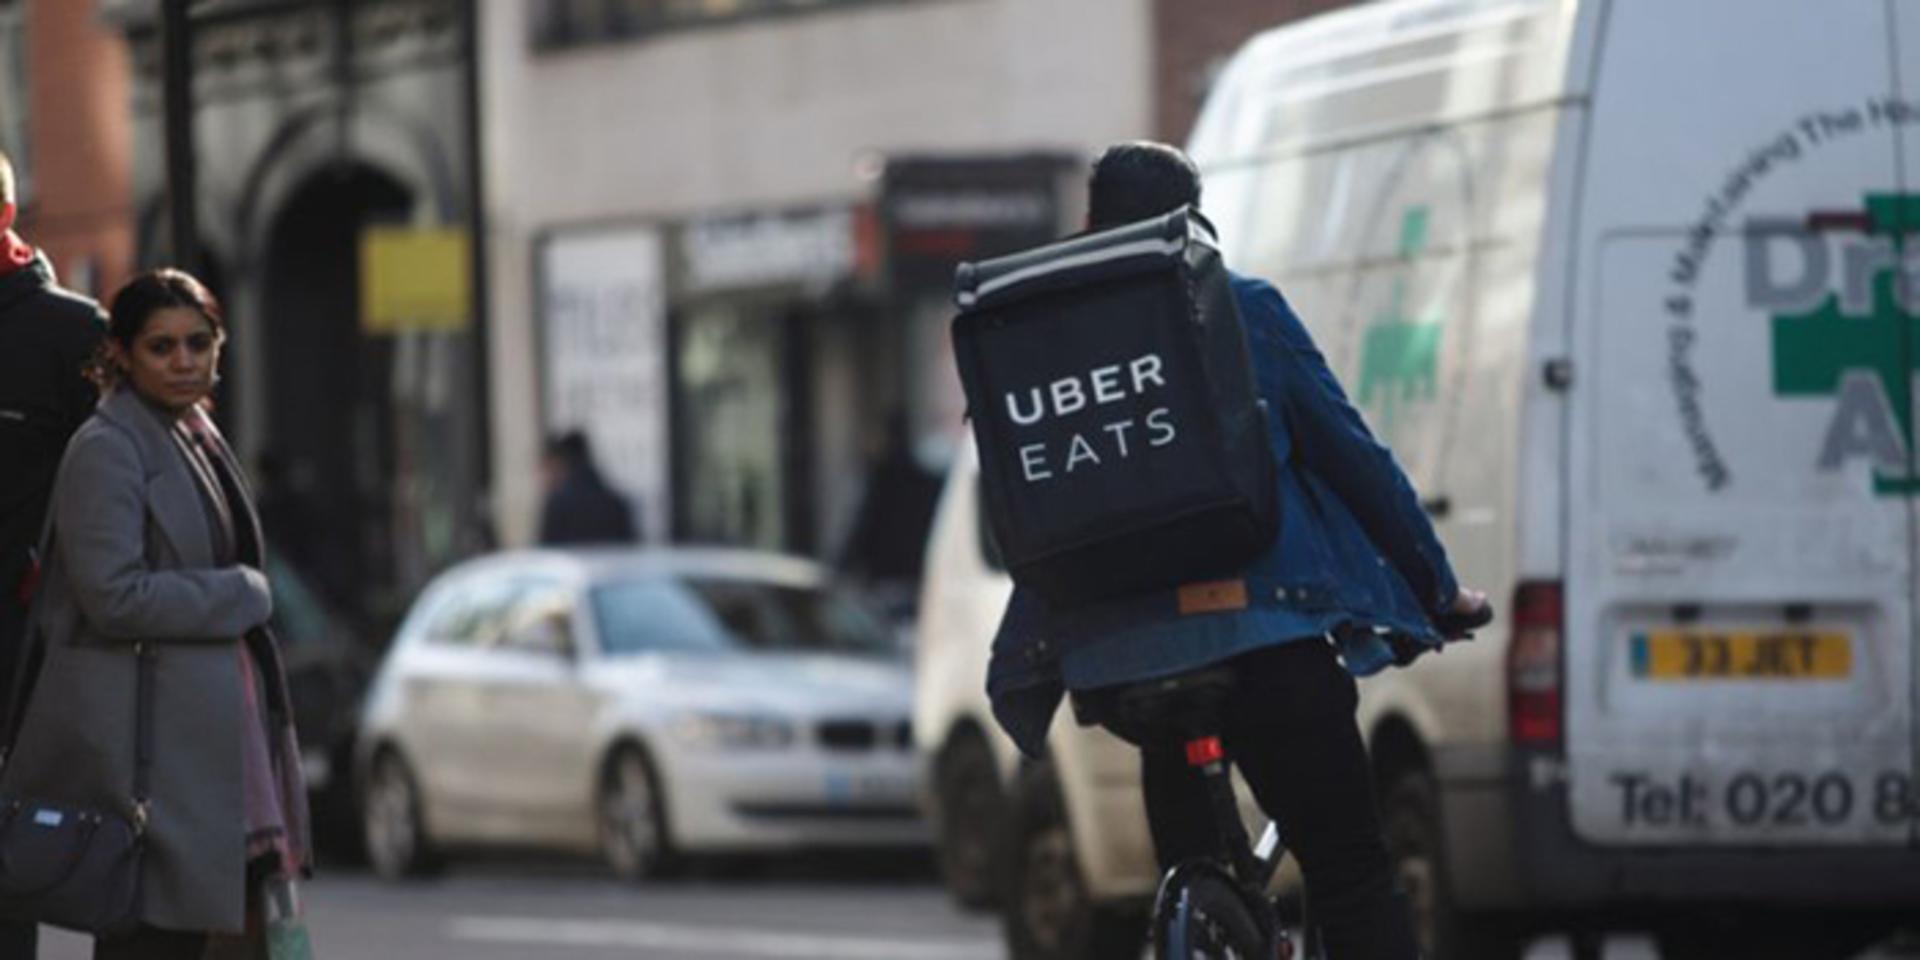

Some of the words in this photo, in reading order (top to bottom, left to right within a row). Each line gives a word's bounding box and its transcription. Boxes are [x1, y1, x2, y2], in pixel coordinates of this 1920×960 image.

[1799, 112, 1862, 147] The
[1005, 353, 1165, 426] UBER
[1019, 407, 1176, 481] EATS
[1725, 770, 1854, 826] 020
